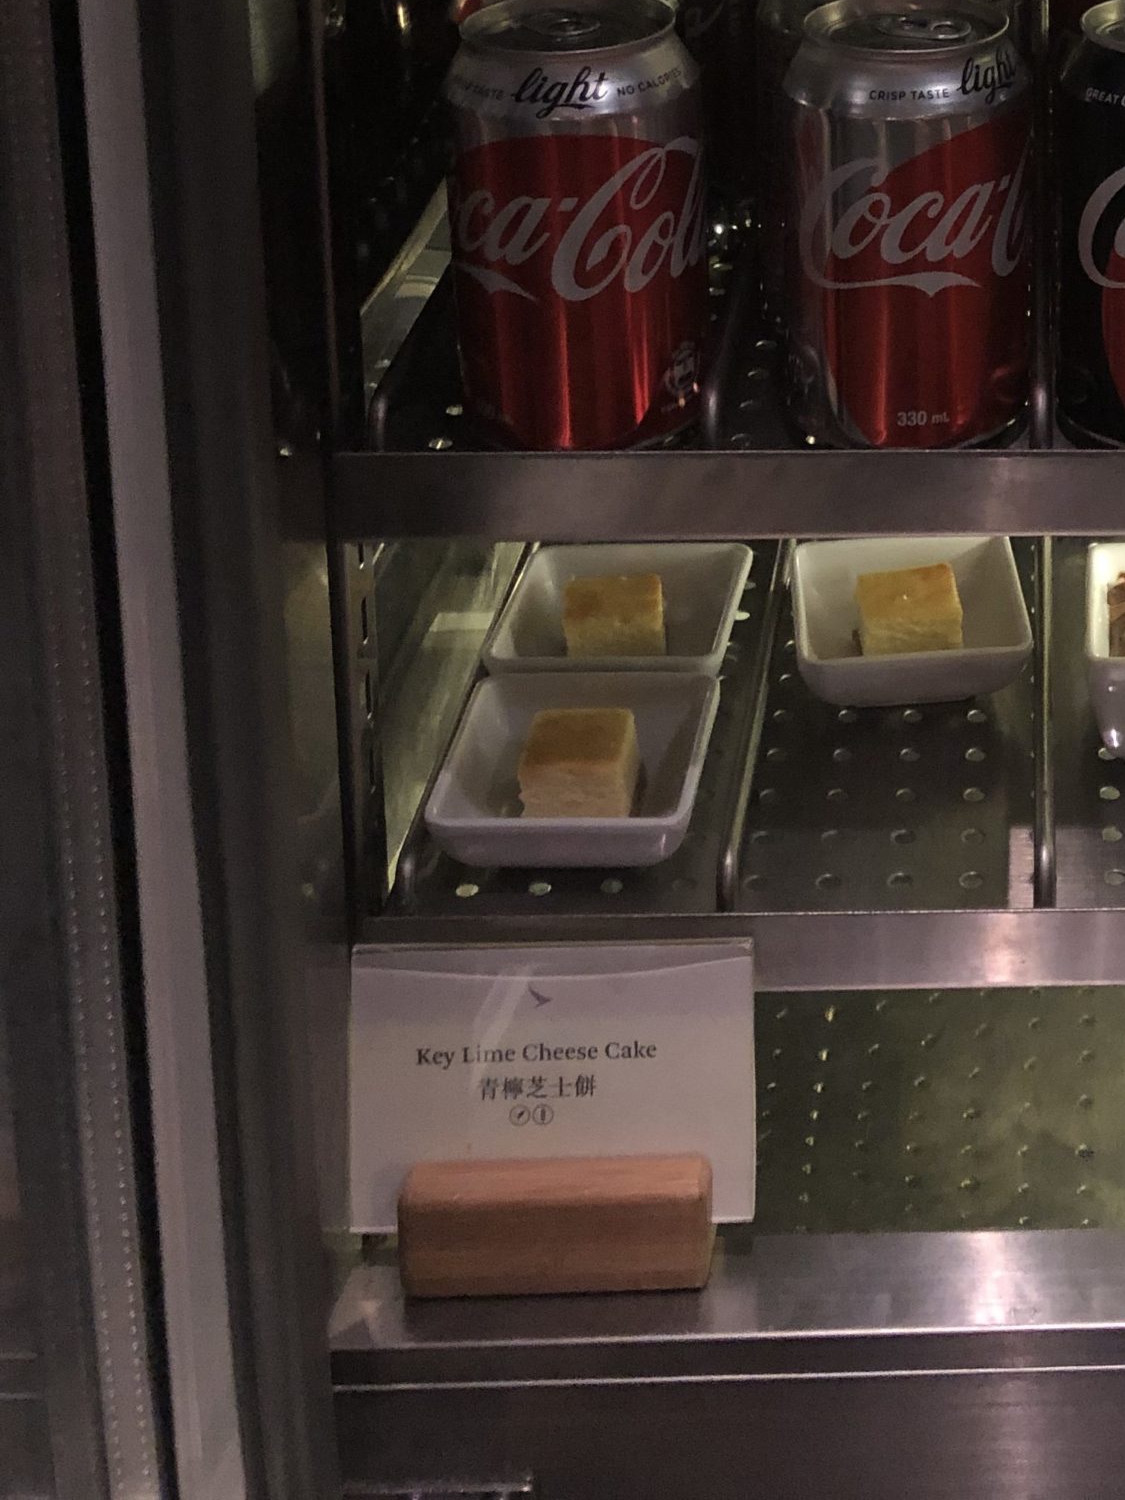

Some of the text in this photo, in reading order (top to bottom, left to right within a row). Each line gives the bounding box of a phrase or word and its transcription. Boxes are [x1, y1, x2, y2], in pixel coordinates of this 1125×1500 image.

[510, 65, 609, 120] light
[617, 85, 636, 98] NO
[869, 89, 907, 102] CRISP
[910, 88, 950, 101] TASTE
[1085, 86, 1124, 105] GREAT
[897, 411, 928, 427] 330
[416, 1040, 658, 1070] Key Lime Cheese Cake
